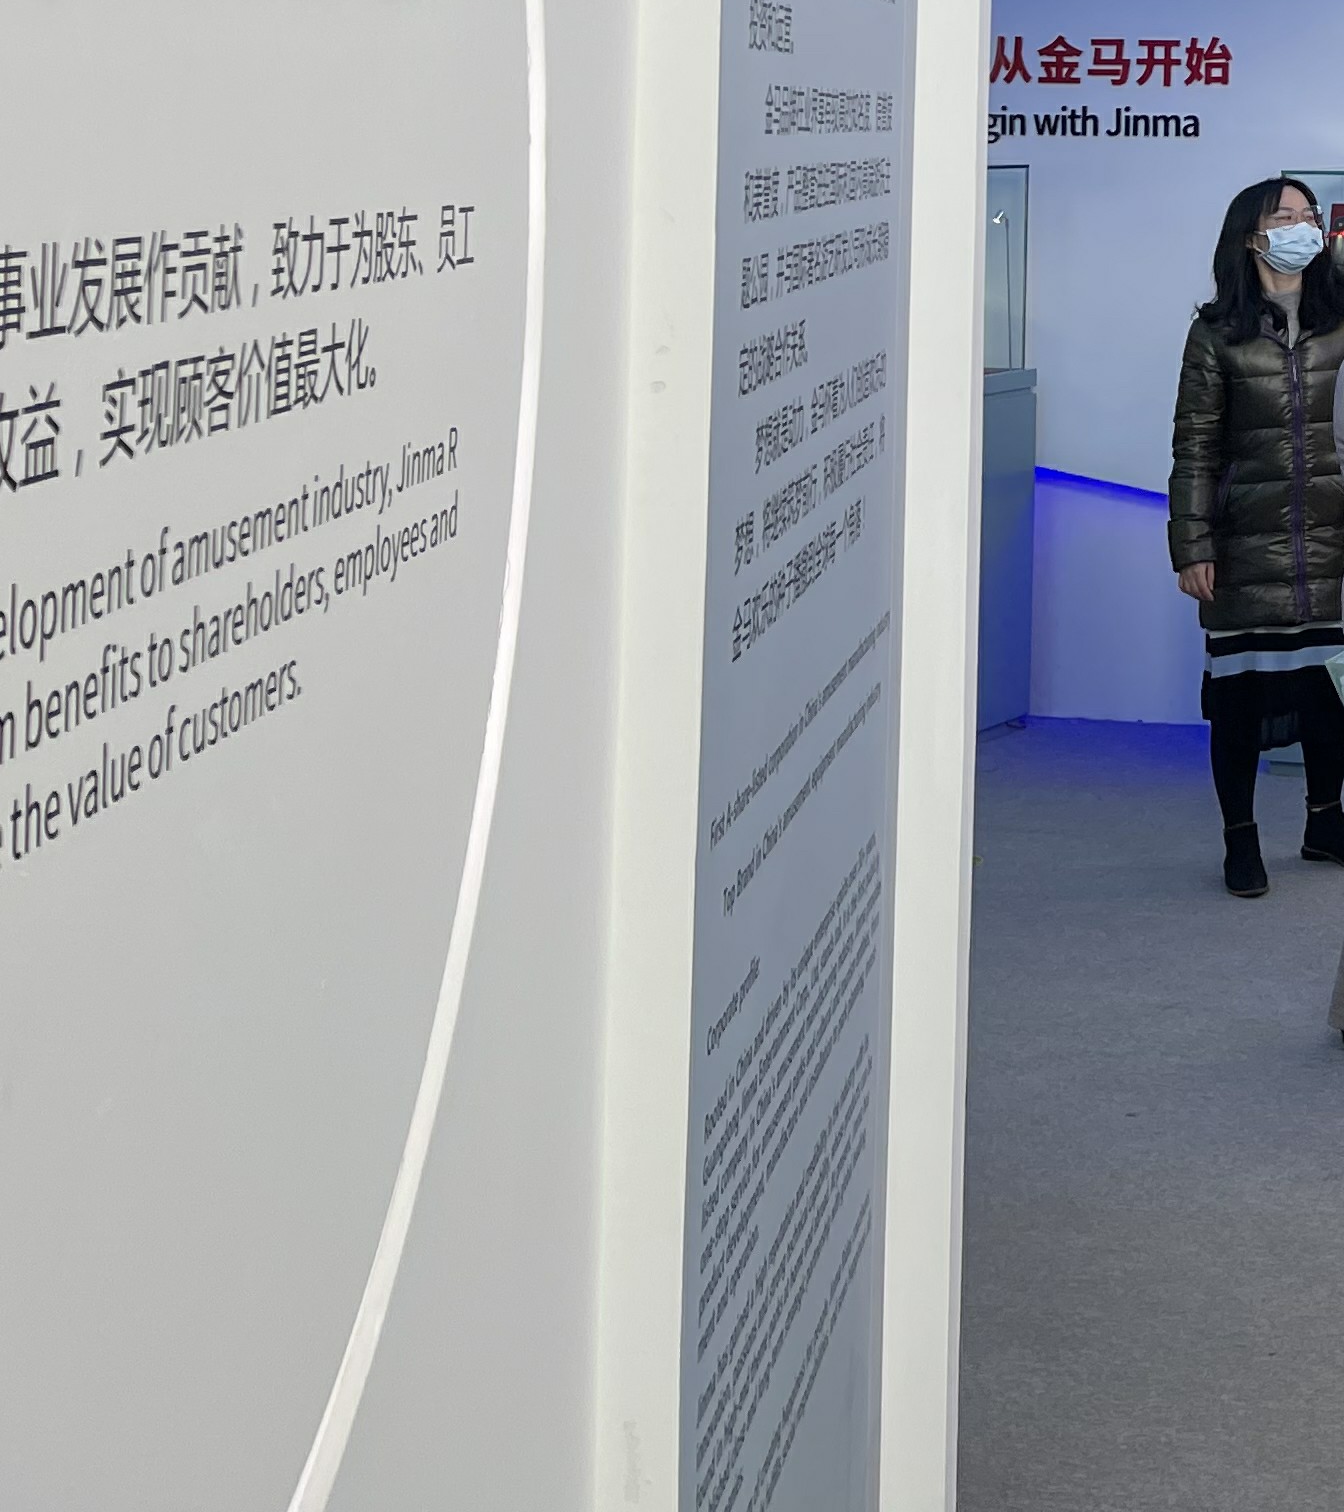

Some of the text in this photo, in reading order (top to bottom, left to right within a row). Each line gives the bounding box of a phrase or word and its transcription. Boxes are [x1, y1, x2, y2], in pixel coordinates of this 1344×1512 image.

[990, 35, 1232, 86] 从金马开始
[1035, 106, 1098, 137] with
[1106, 106, 1199, 137] Jinma
[140, 527, 171, 598] of
[172, 490, 309, 585] amusement
[312, 457, 393, 532] industry,
[396, 439, 444, 492] Jinma
[445, 426, 458, 471] R
[25, 644, 141, 752] benefits
[147, 632, 173, 688] to
[179, 563, 330, 674] shareholders,
[333, 520, 427, 597] employees
[429, 491, 459, 558] and
[10, 659, 301, 860] the value of customers.
